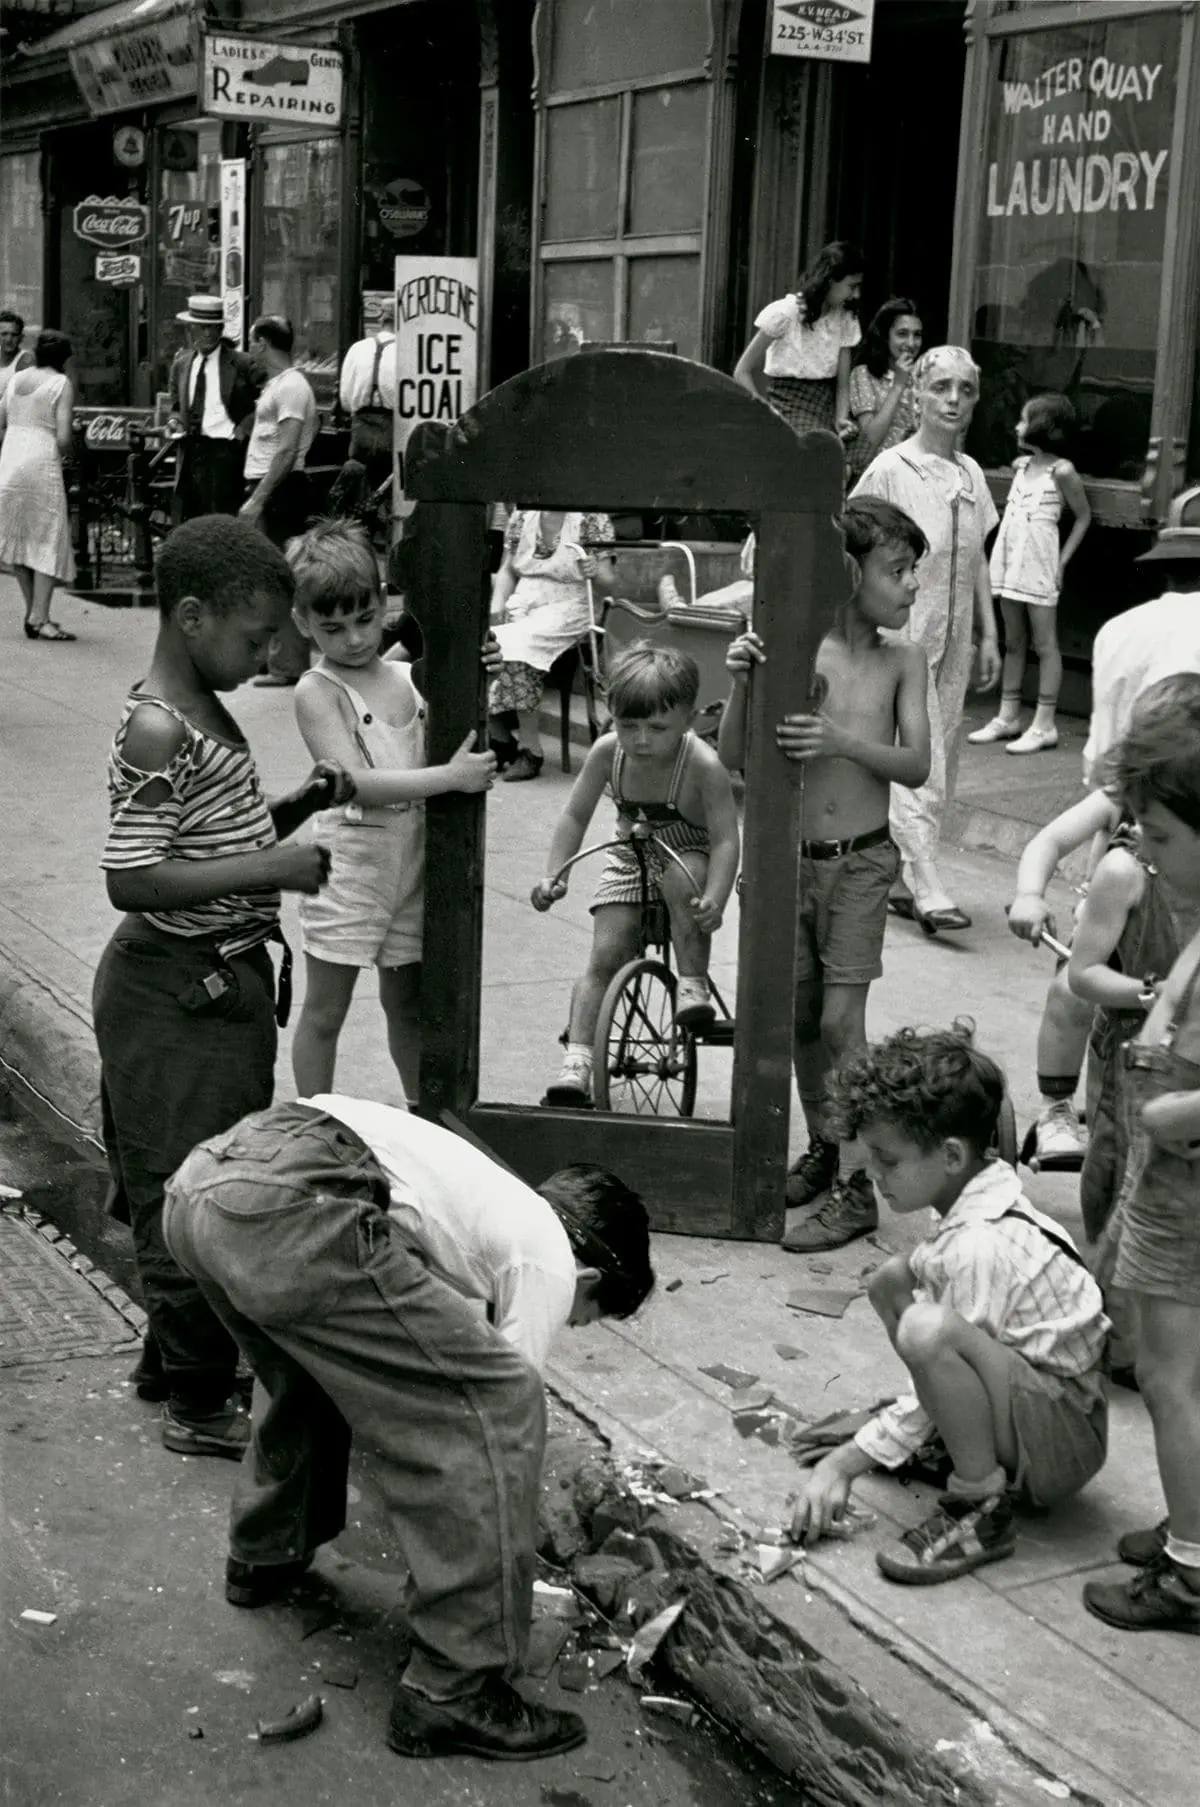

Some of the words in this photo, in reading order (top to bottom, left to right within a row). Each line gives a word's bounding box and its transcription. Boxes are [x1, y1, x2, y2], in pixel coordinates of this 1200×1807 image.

[213, 39, 257, 60] LADIES
[310, 53, 342, 69] GENTS
[213, 66, 336, 115] REPAIRING
[1003, 58, 1083, 114] WALTER
[1089, 56, 1163, 102] QUAY
[1042, 110, 1112, 145] HAND
[987, 149, 1168, 216] LAUNDRY
[397, 275, 477, 331] KEROSENE
[417, 333, 462, 375] ICE
